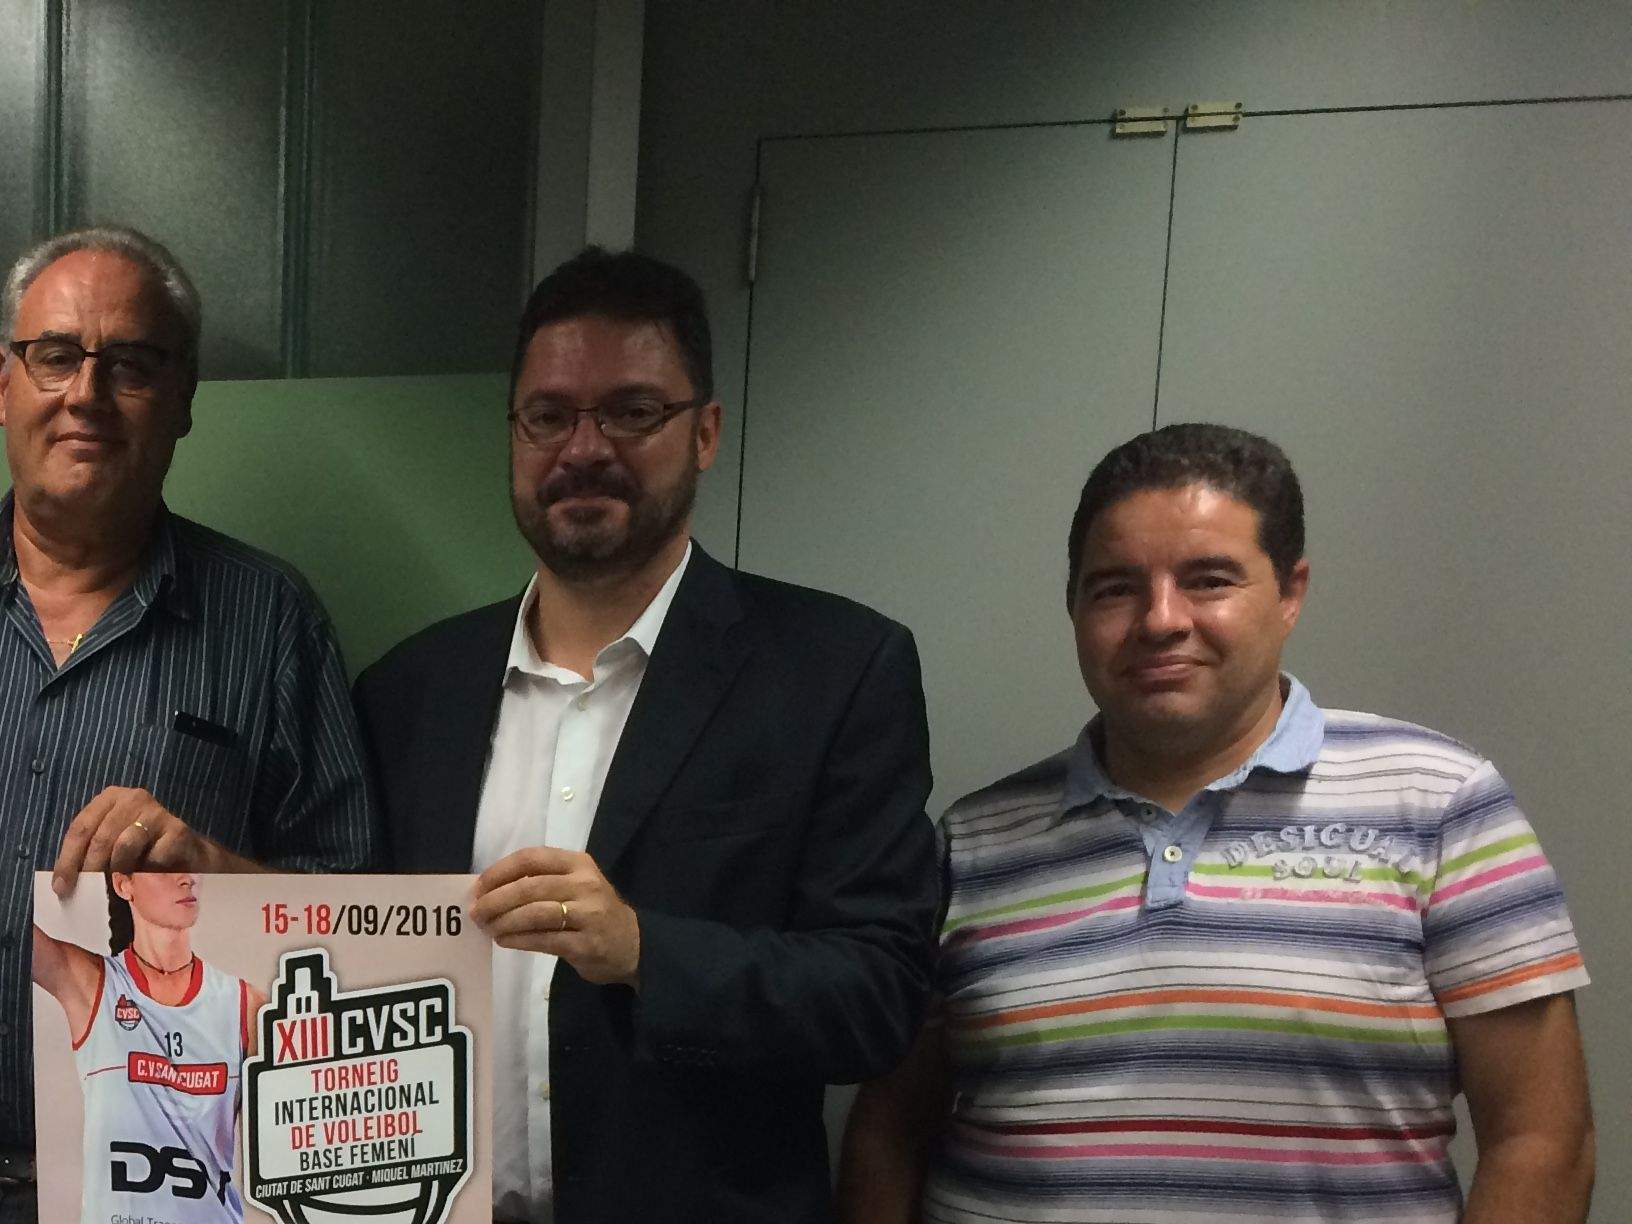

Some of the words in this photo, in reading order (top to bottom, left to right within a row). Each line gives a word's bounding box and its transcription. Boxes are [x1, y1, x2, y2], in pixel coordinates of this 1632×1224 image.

[261, 904, 461, 936] 15-18/09/2016
[165, 1032, 183, 1057] 13
[277, 1016, 329, 1063] XIII
[341, 998, 442, 1055] CVSC
[311, 1059, 399, 1093] TORNEIG
[275, 1081, 439, 1125] INTERNACIONAL
[291, 1124, 315, 1150] DE
[324, 1111, 423, 1145] VOLEIBOL
[300, 1147, 343, 1171] BASE
[350, 1133, 417, 1165] FEMENÍ
[256, 1181, 289, 1198] CIUTAT
[290, 1180, 303, 1194] DE
[305, 1176, 331, 1192] SANT
[333, 1172, 365, 1189] CUGAT
[372, 1166, 409, 1183] MIQUEL
[411, 1159, 463, 1178] MARTINEZ
